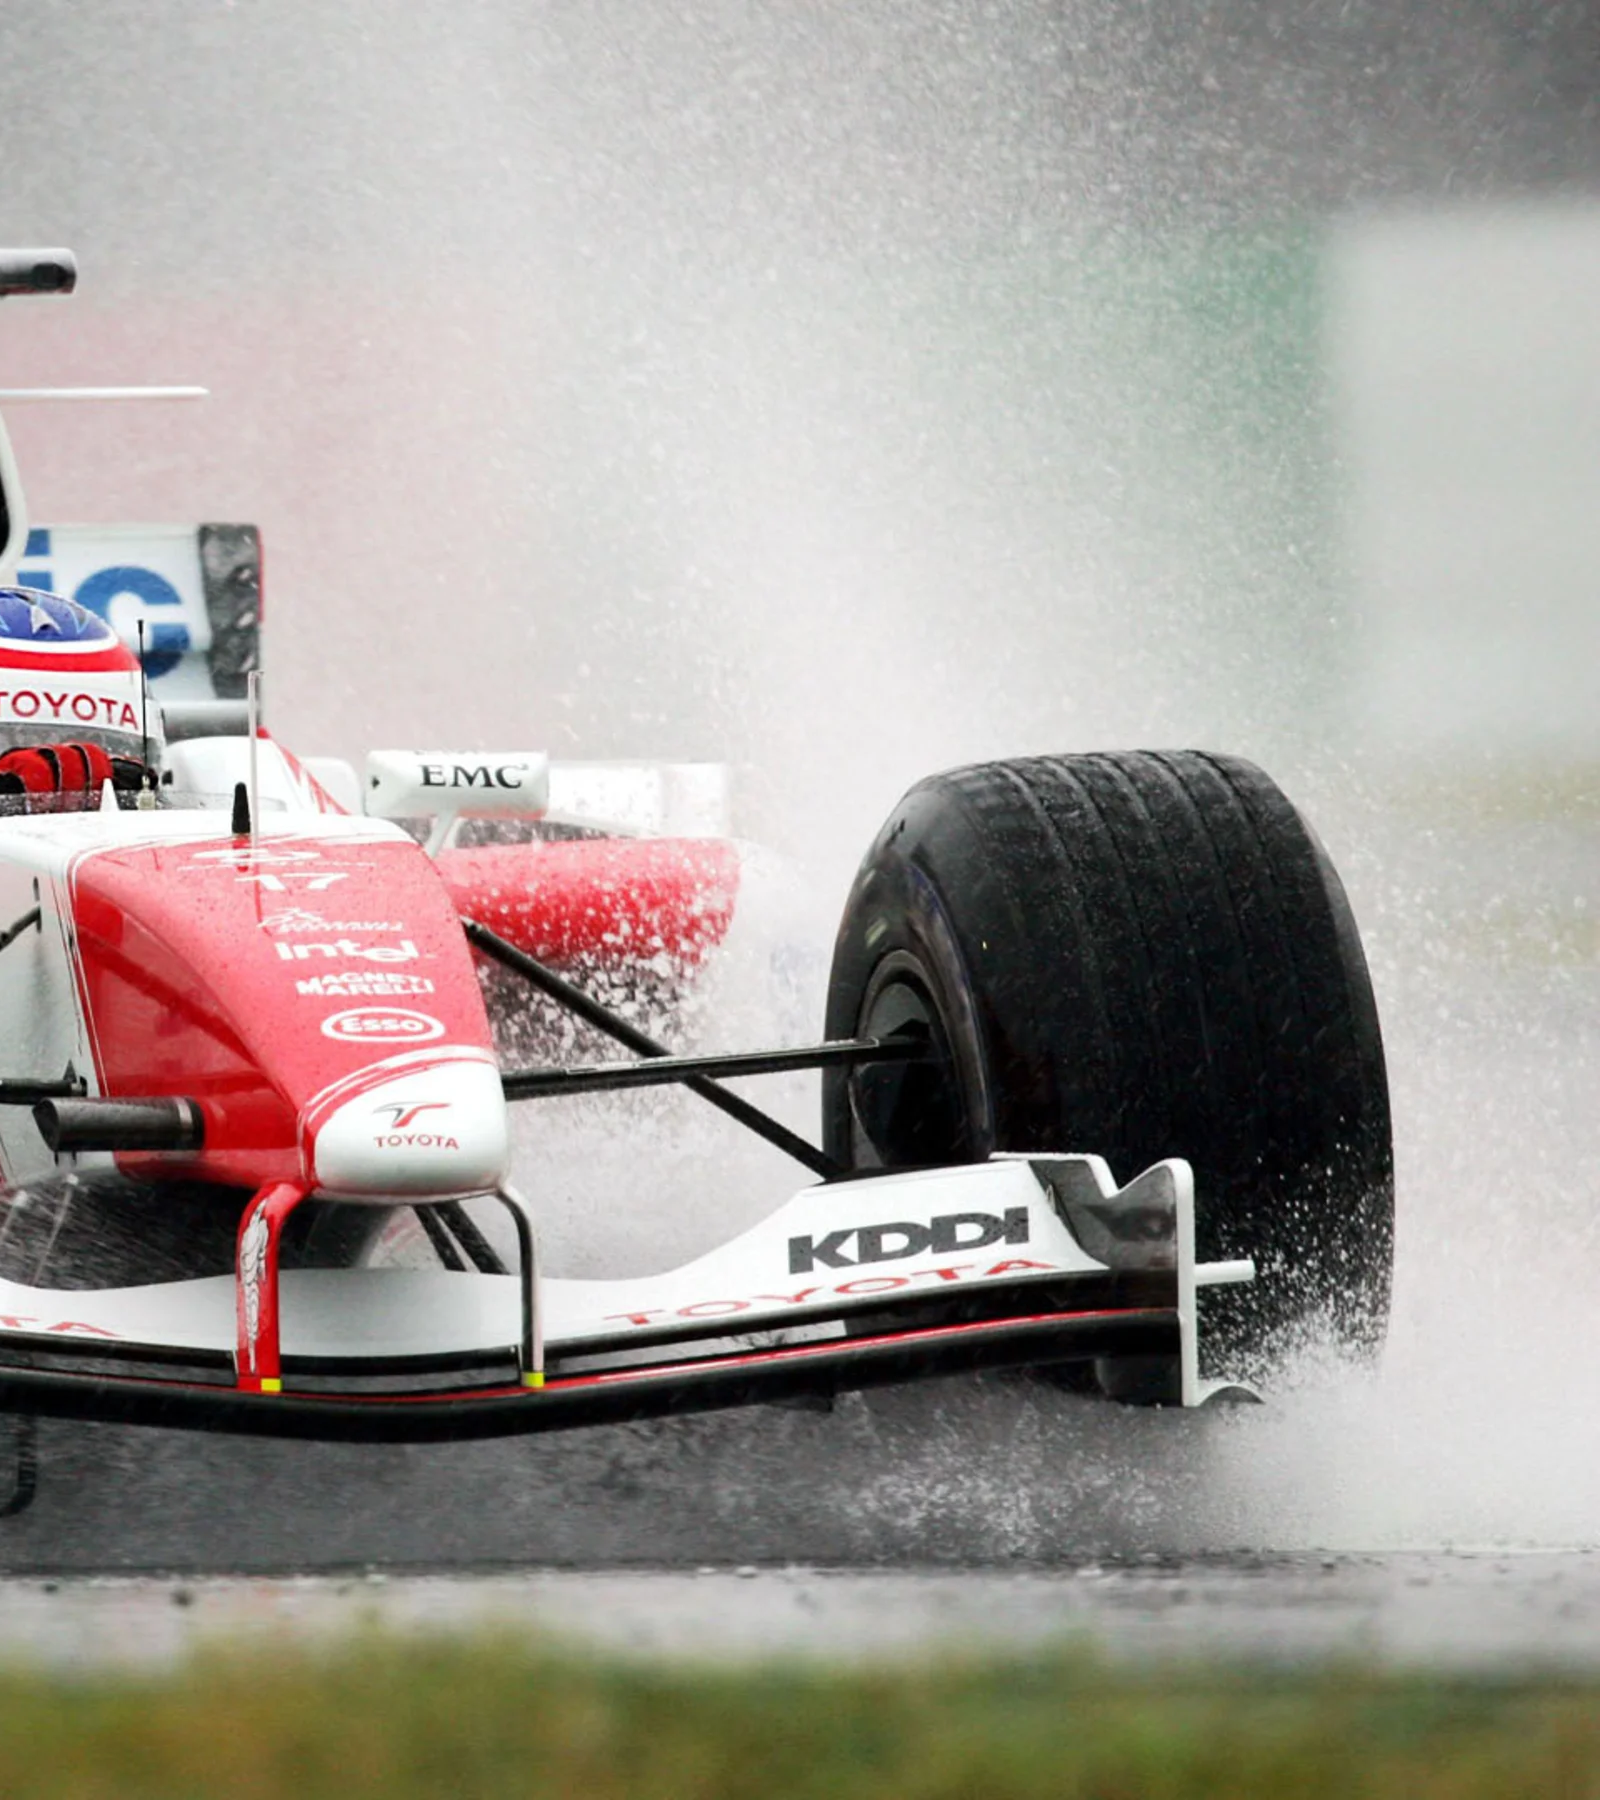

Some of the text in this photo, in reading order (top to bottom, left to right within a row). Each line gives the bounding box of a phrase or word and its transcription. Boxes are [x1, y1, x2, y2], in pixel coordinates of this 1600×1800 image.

[235, 873, 348, 891] 17
[296, 979, 435, 996] MARELLI
[374, 1134, 459, 1150] TOYOTA
[788, 1206, 1029, 1275] KDDI
[605, 1258, 1060, 1326] TOYOTA
